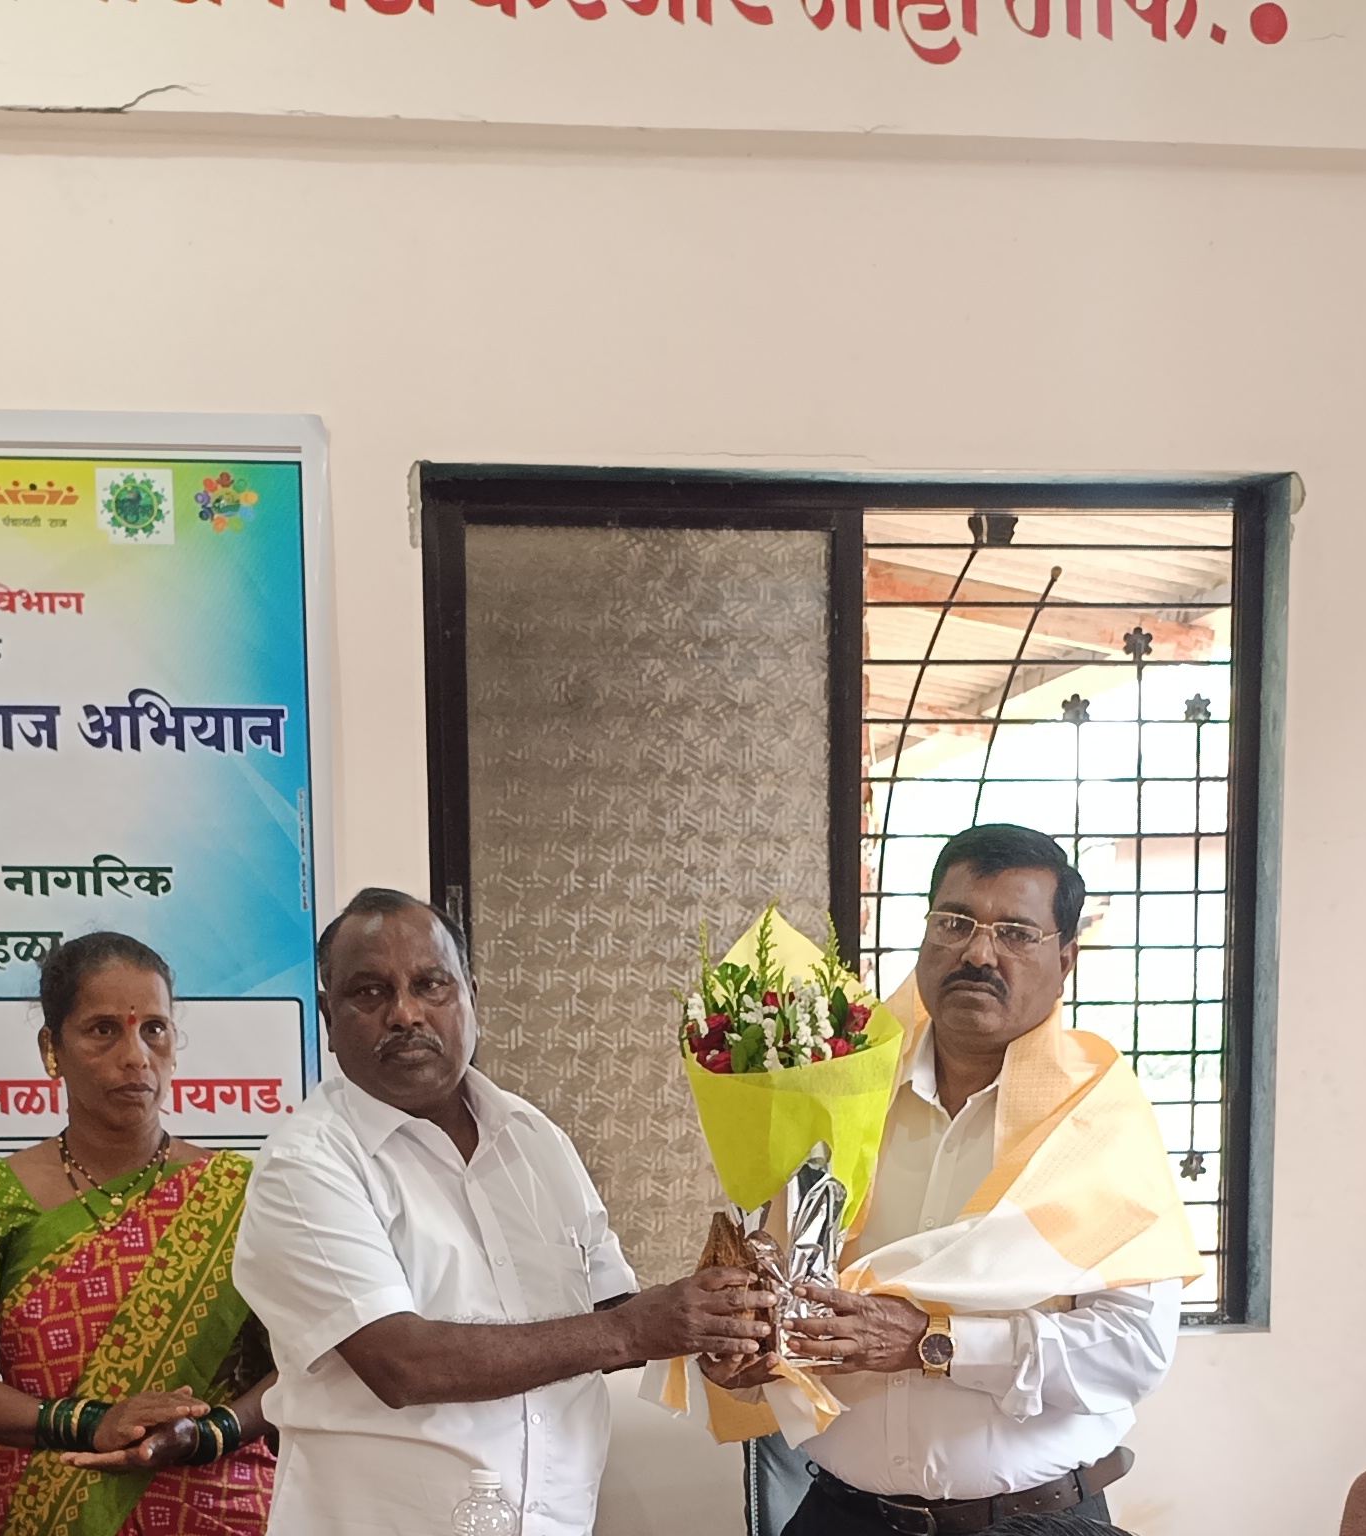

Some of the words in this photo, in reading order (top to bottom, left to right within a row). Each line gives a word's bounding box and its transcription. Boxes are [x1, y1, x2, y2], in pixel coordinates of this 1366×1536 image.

[76, 688, 287, 756] अभियान
[1, 854, 174, 899] नागरिक
[159, 1078, 294, 1116] ायगड.
